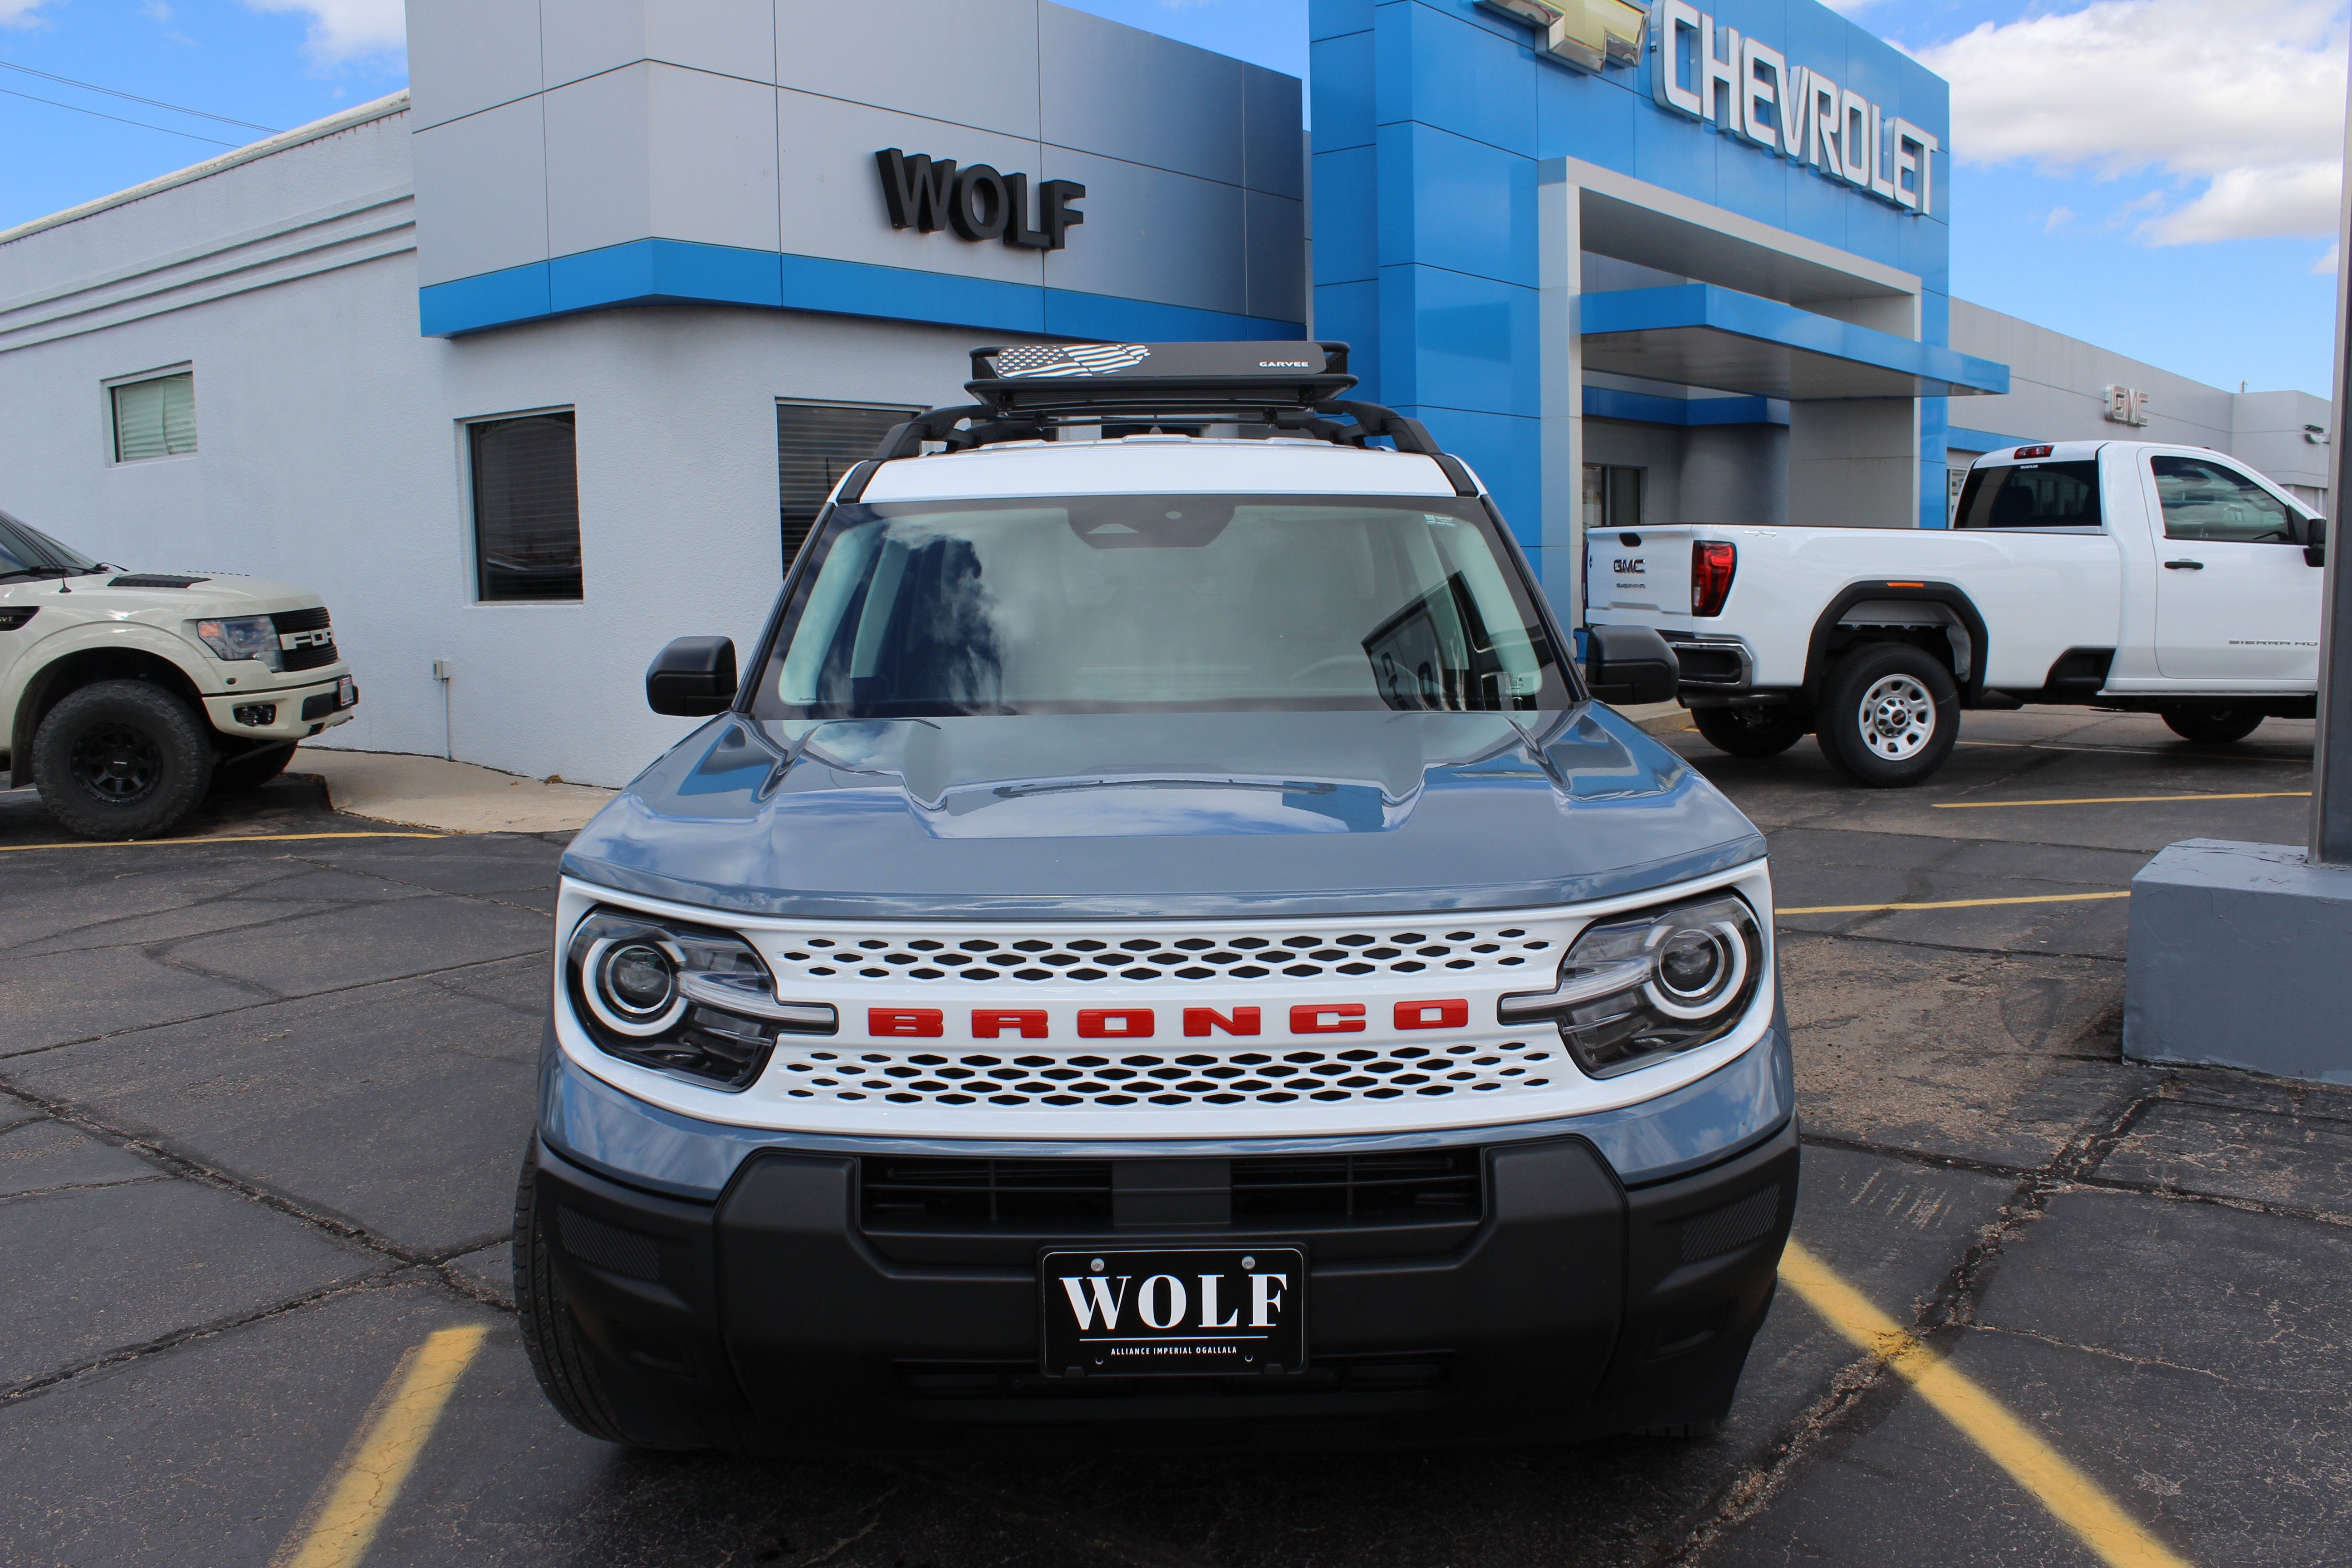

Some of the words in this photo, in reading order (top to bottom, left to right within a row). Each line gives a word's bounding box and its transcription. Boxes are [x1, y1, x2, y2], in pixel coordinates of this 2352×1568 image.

[1651, 0, 1938, 216] CHEVROLET
[876, 148, 1086, 252] WOLF
[2107, 385, 2149, 426] GMC
[1613, 559, 1646, 573] GMC
[279, 626, 334, 650] FOR
[868, 999, 1469, 1039] BRONCO
[1059, 1274, 1287, 1330] WOLF
